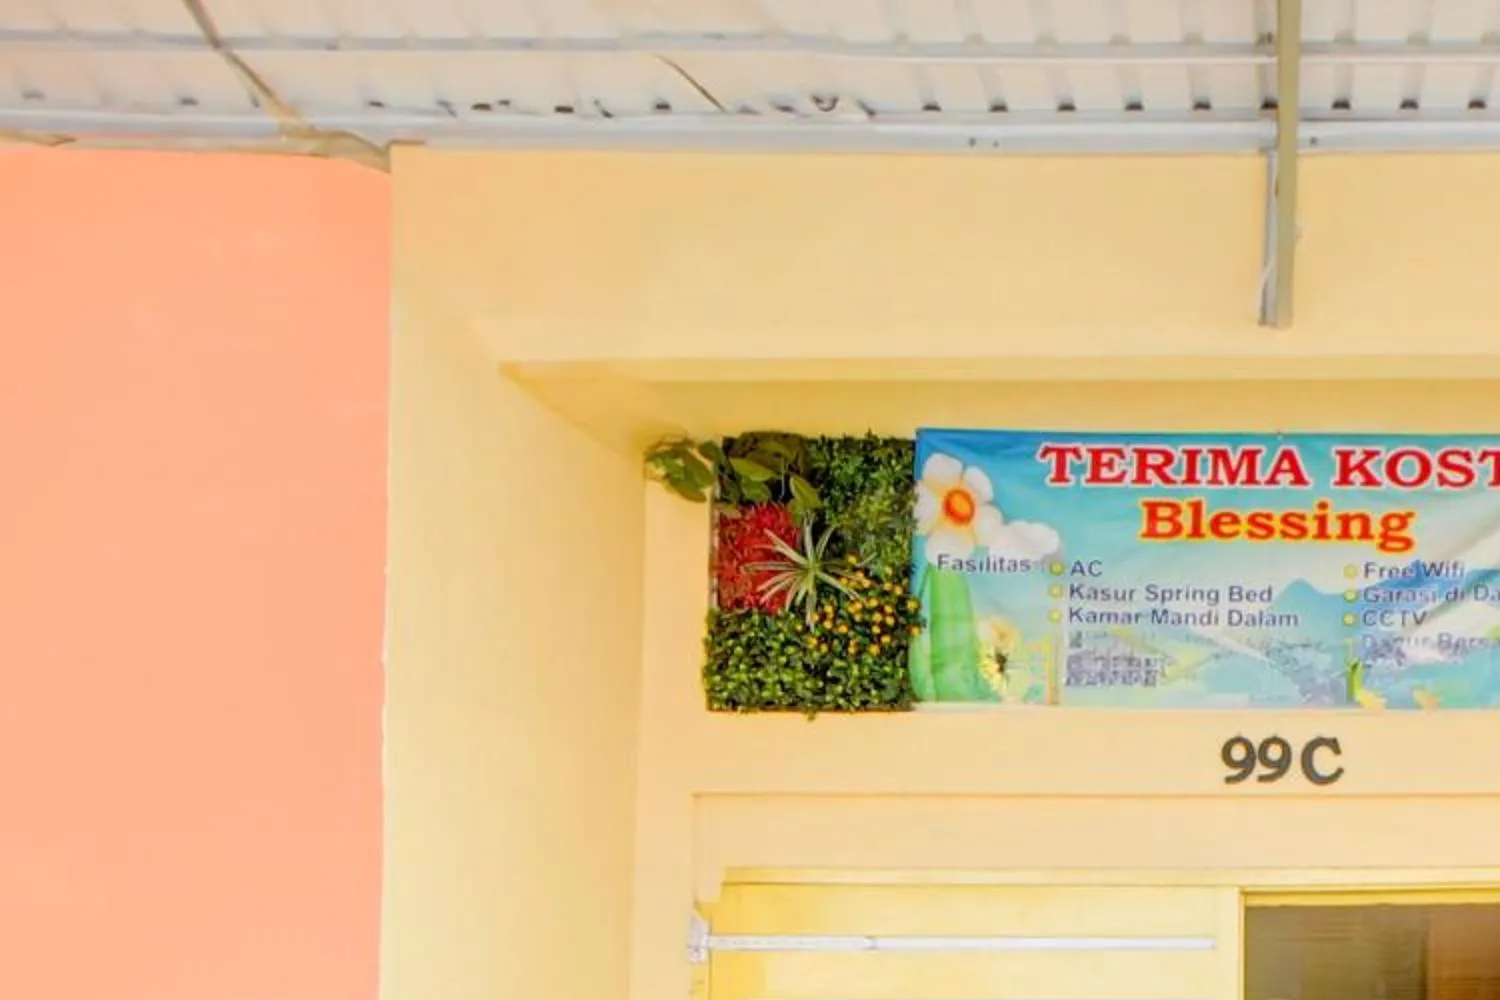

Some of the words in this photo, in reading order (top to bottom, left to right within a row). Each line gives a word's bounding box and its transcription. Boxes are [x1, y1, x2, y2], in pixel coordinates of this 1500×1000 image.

[1039, 446, 1311, 486] TERIMA
[1140, 500, 1416, 553] Blessing
[936, 553, 1032, 573] Fasilitas
[1070, 560, 1103, 577] AC
[1363, 561, 1414, 578] Free
[1068, 583, 1136, 602] Kasur
[1145, 584, 1220, 606] Spring
[1228, 585, 1274, 603] Bed
[1363, 586, 1438, 603] Garasi
[1068, 608, 1142, 625] Kamar
[1150, 608, 1220, 626] Mandi
[1227, 610, 1299, 628] Dalam
[1362, 609, 1428, 627] CCTV
